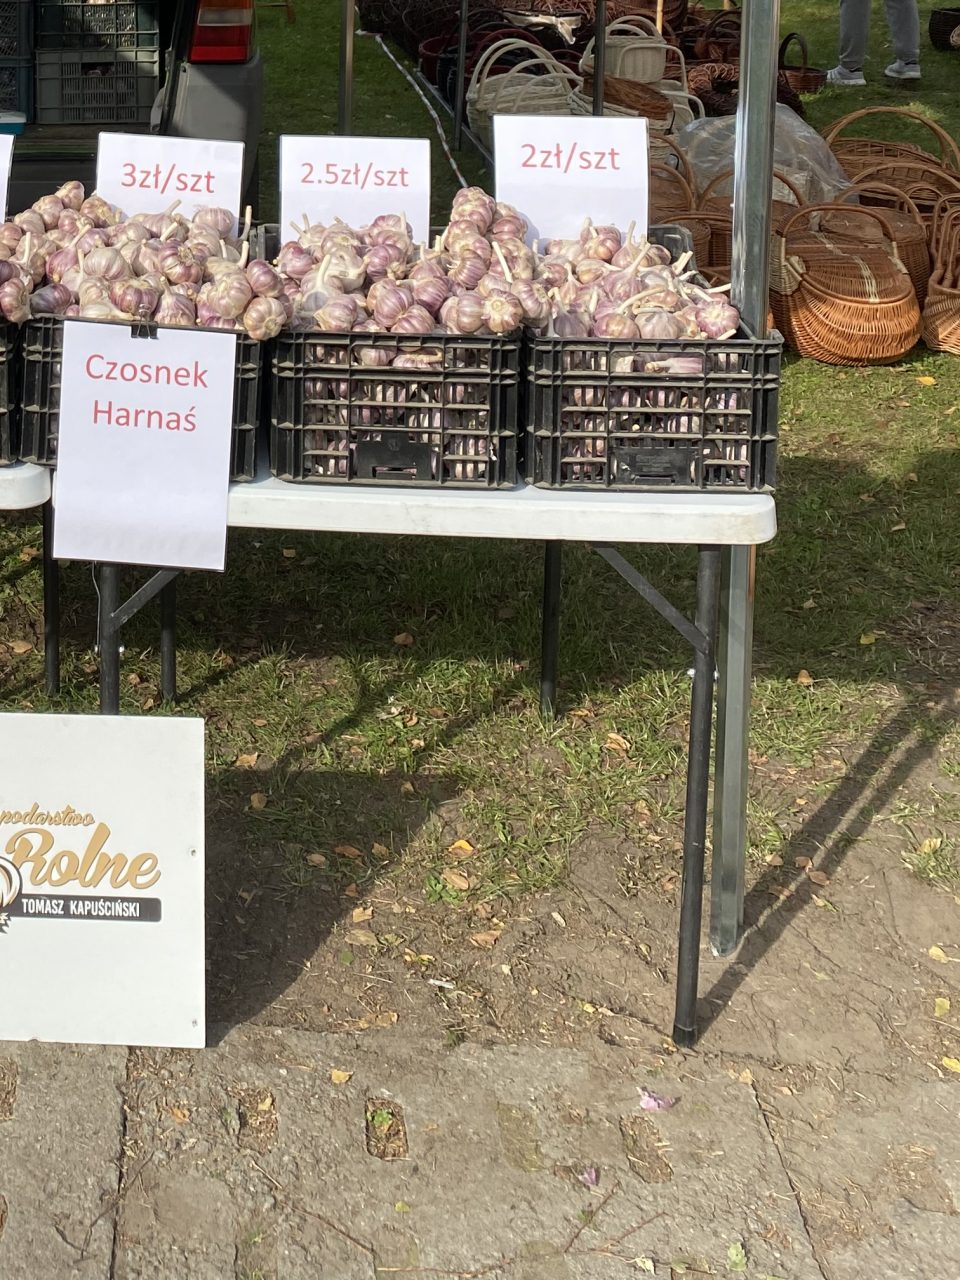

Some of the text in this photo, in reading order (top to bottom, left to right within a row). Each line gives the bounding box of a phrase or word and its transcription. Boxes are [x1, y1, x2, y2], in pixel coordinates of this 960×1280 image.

[520, 142, 621, 173] 2zł/szt
[120, 163, 216, 194] 3zł/szt
[300, 162, 409, 189] 2.5zł/szt
[85, 353, 209, 388] Czosnek
[93, 399, 197, 432] Harnaś
[5, 822, 162, 889] Rolne
[21, 898, 141, 917] TOMASZ KAPUŚCIŃSKI
